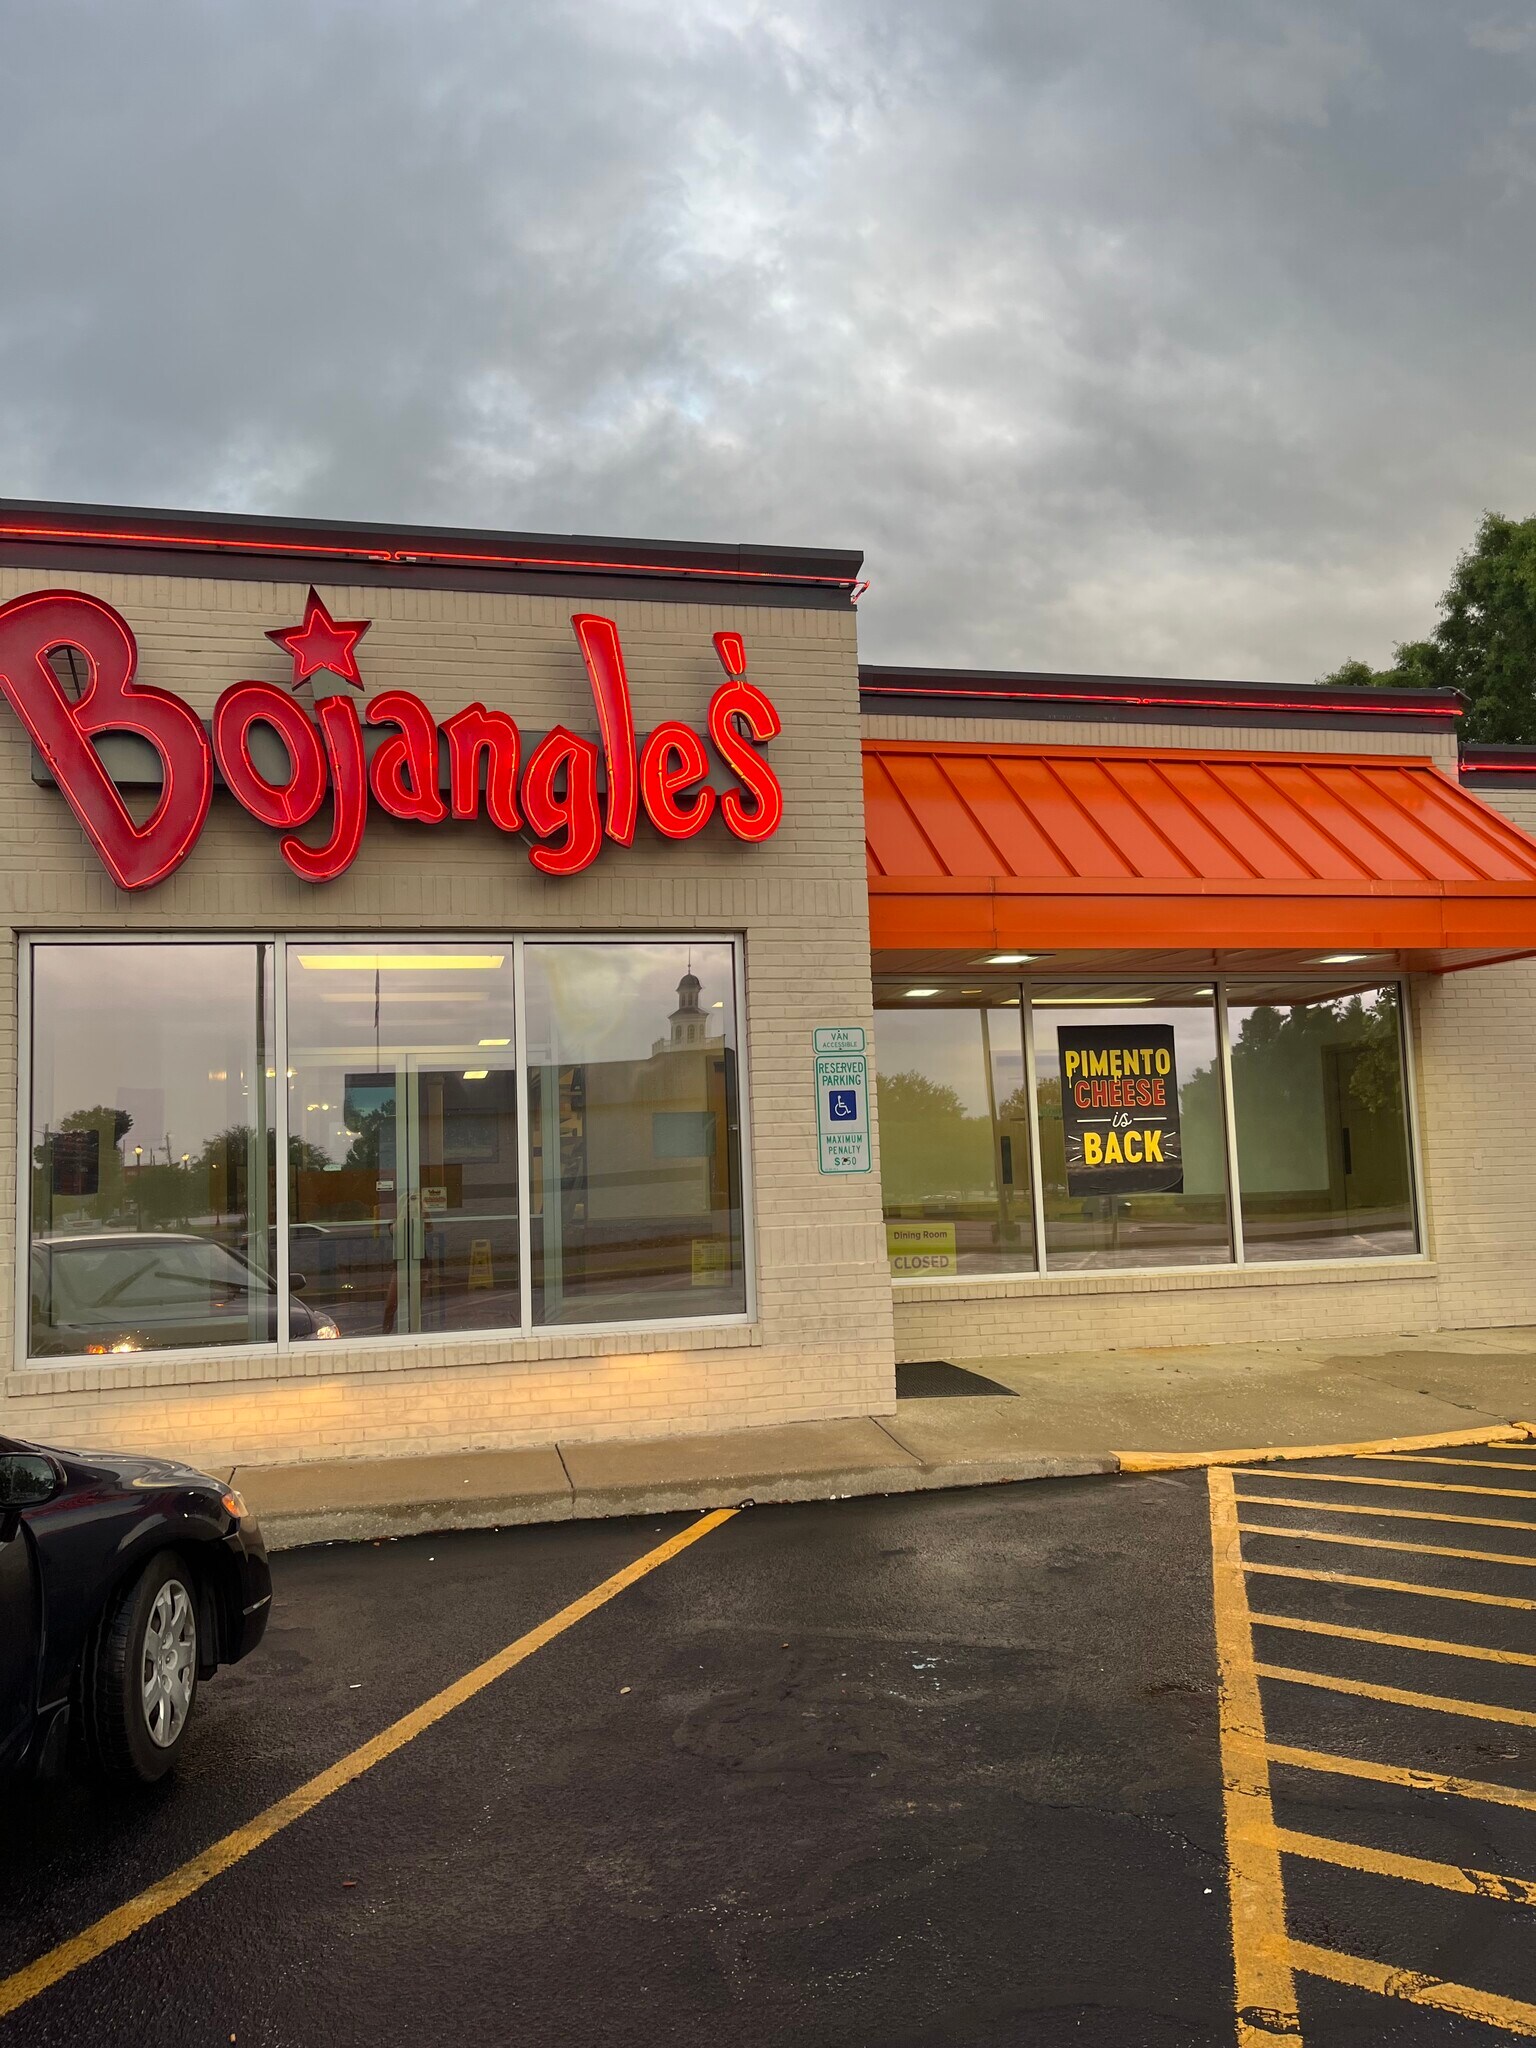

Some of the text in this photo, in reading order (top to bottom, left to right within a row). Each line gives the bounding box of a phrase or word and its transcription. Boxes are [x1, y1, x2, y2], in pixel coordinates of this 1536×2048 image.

[0, 588, 782, 892] Bojangle's
[830, 1033, 849, 1041] VAN
[818, 1062, 864, 1074] RESERVED
[1065, 1048, 1171, 1080] PIMENTO
[822, 1074, 861, 1086] PARKING
[1074, 1078, 1166, 1109] CHEESE
[1111, 1111, 1133, 1128] is
[826, 1135, 863, 1144] MAXIMUM
[828, 1145, 861, 1155] PENALTY
[1083, 1130, 1164, 1165] BACK
[834, 1156, 857, 1166] $250
[893, 1230, 948, 1240] Dining Room
[894, 1255, 949, 1269] CLOSED
